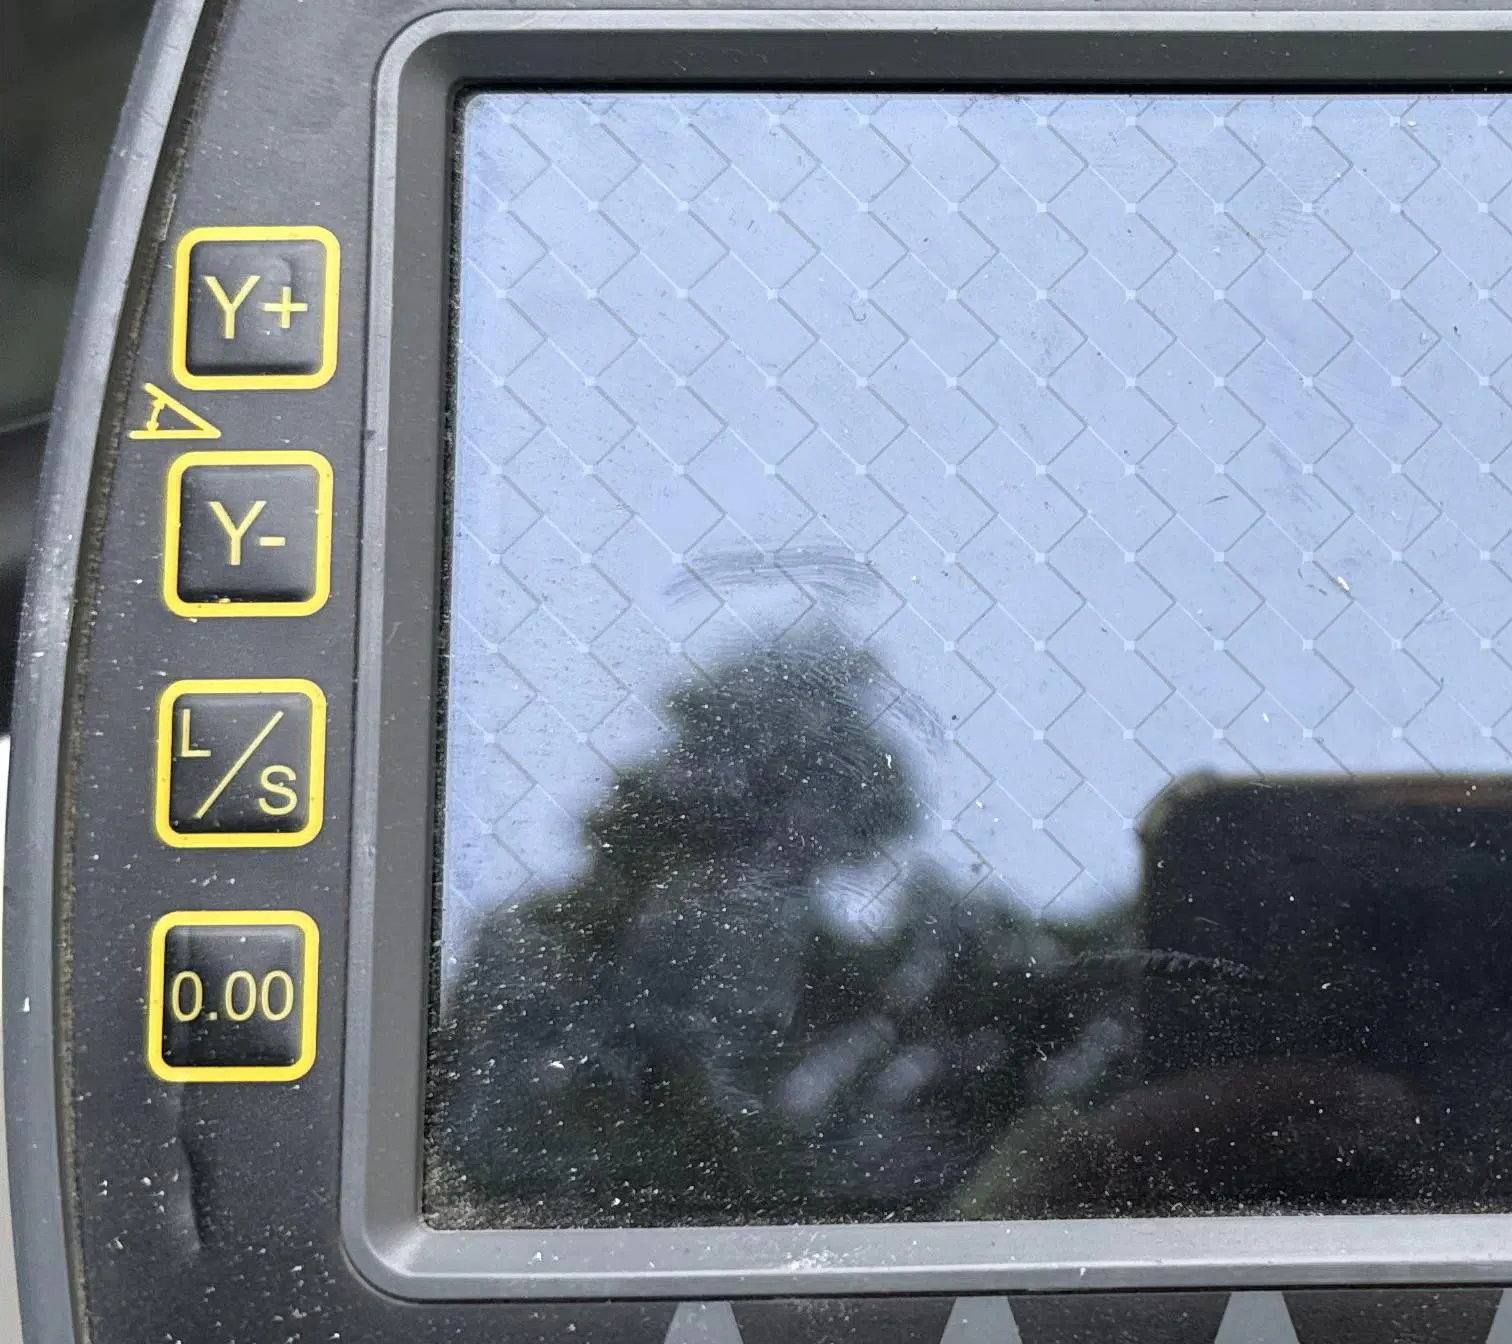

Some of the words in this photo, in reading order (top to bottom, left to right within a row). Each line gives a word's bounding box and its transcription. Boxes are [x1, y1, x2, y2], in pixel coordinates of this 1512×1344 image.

[203, 274, 309, 340] Y+
[209, 499, 287, 563] Y-
[169, 969, 294, 1023] 0.00
